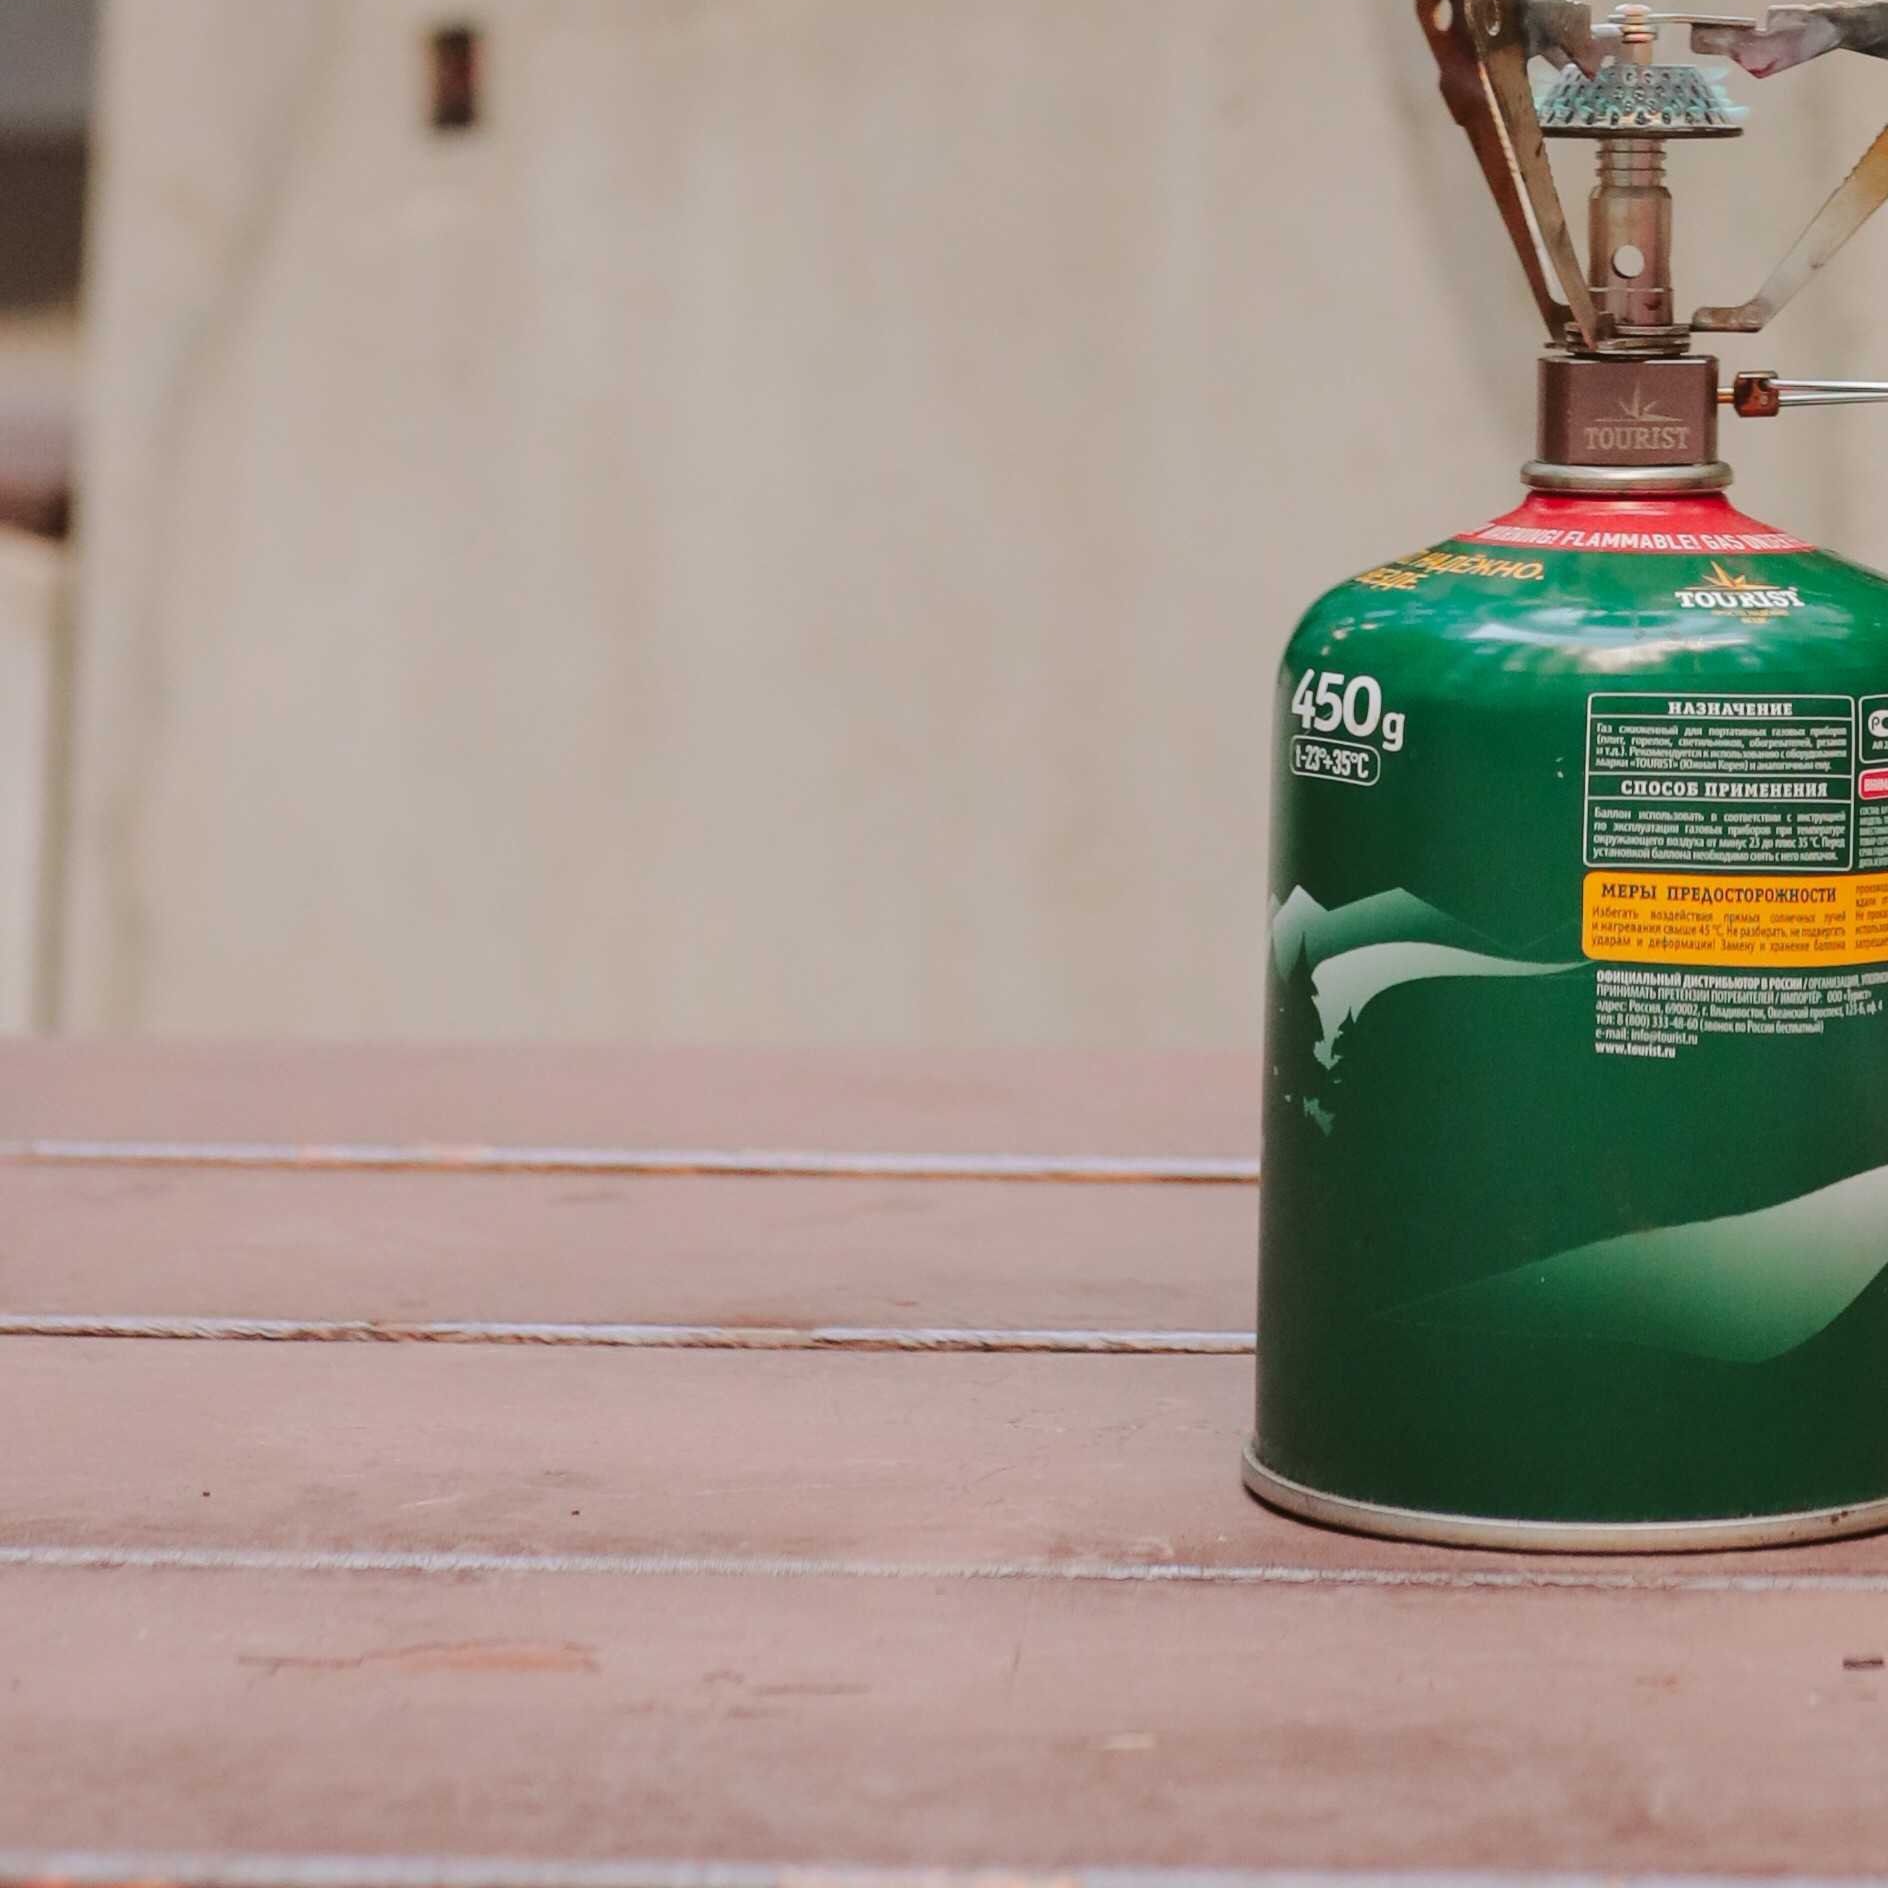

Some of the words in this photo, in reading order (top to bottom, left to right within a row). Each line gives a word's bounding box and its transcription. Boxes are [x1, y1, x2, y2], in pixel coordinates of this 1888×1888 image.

[1584, 426, 1691, 450] TOURIST
[1561, 529, 1701, 551] FLAMMABLE!
[1700, 533, 1745, 550] GAS
[1668, 701, 1793, 716] НАЗНАЧЕНИЕ
[1621, 780, 1699, 797] СПОСОБ
[1704, 782, 1828, 798] ПРИМЕНЕНИЯ
[1594, 806, 1631, 819] Баллон
[1601, 883, 1657, 900] МЕРЫ
[1667, 885, 1837, 905] ПРЕДОСТОРОЖНОСТИ
[1596, 969, 1682, 987] ОФИЦИАЛЬНЫЙ
[1682, 974, 1761, 991] ДИСТРИБЬЮТОР
[1769, 977, 1803, 990] РОССИИ
[1596, 984, 1657, 1000] ПРИНИМАТЬ
[1657, 987, 1710, 1003] ПРЕТЕНЗИИ
[1595, 1000, 1628, 1013] адрес:
[1616, 1013, 1624, 1026] 8
[1625, 1013, 1650, 1028] (800)
[1595, 1026, 1630, 1041] e-mail:
[1630, 1028, 1698, 1046] info@tourist.ru
[1594, 1041, 1677, 1059] www.tourist.ru
